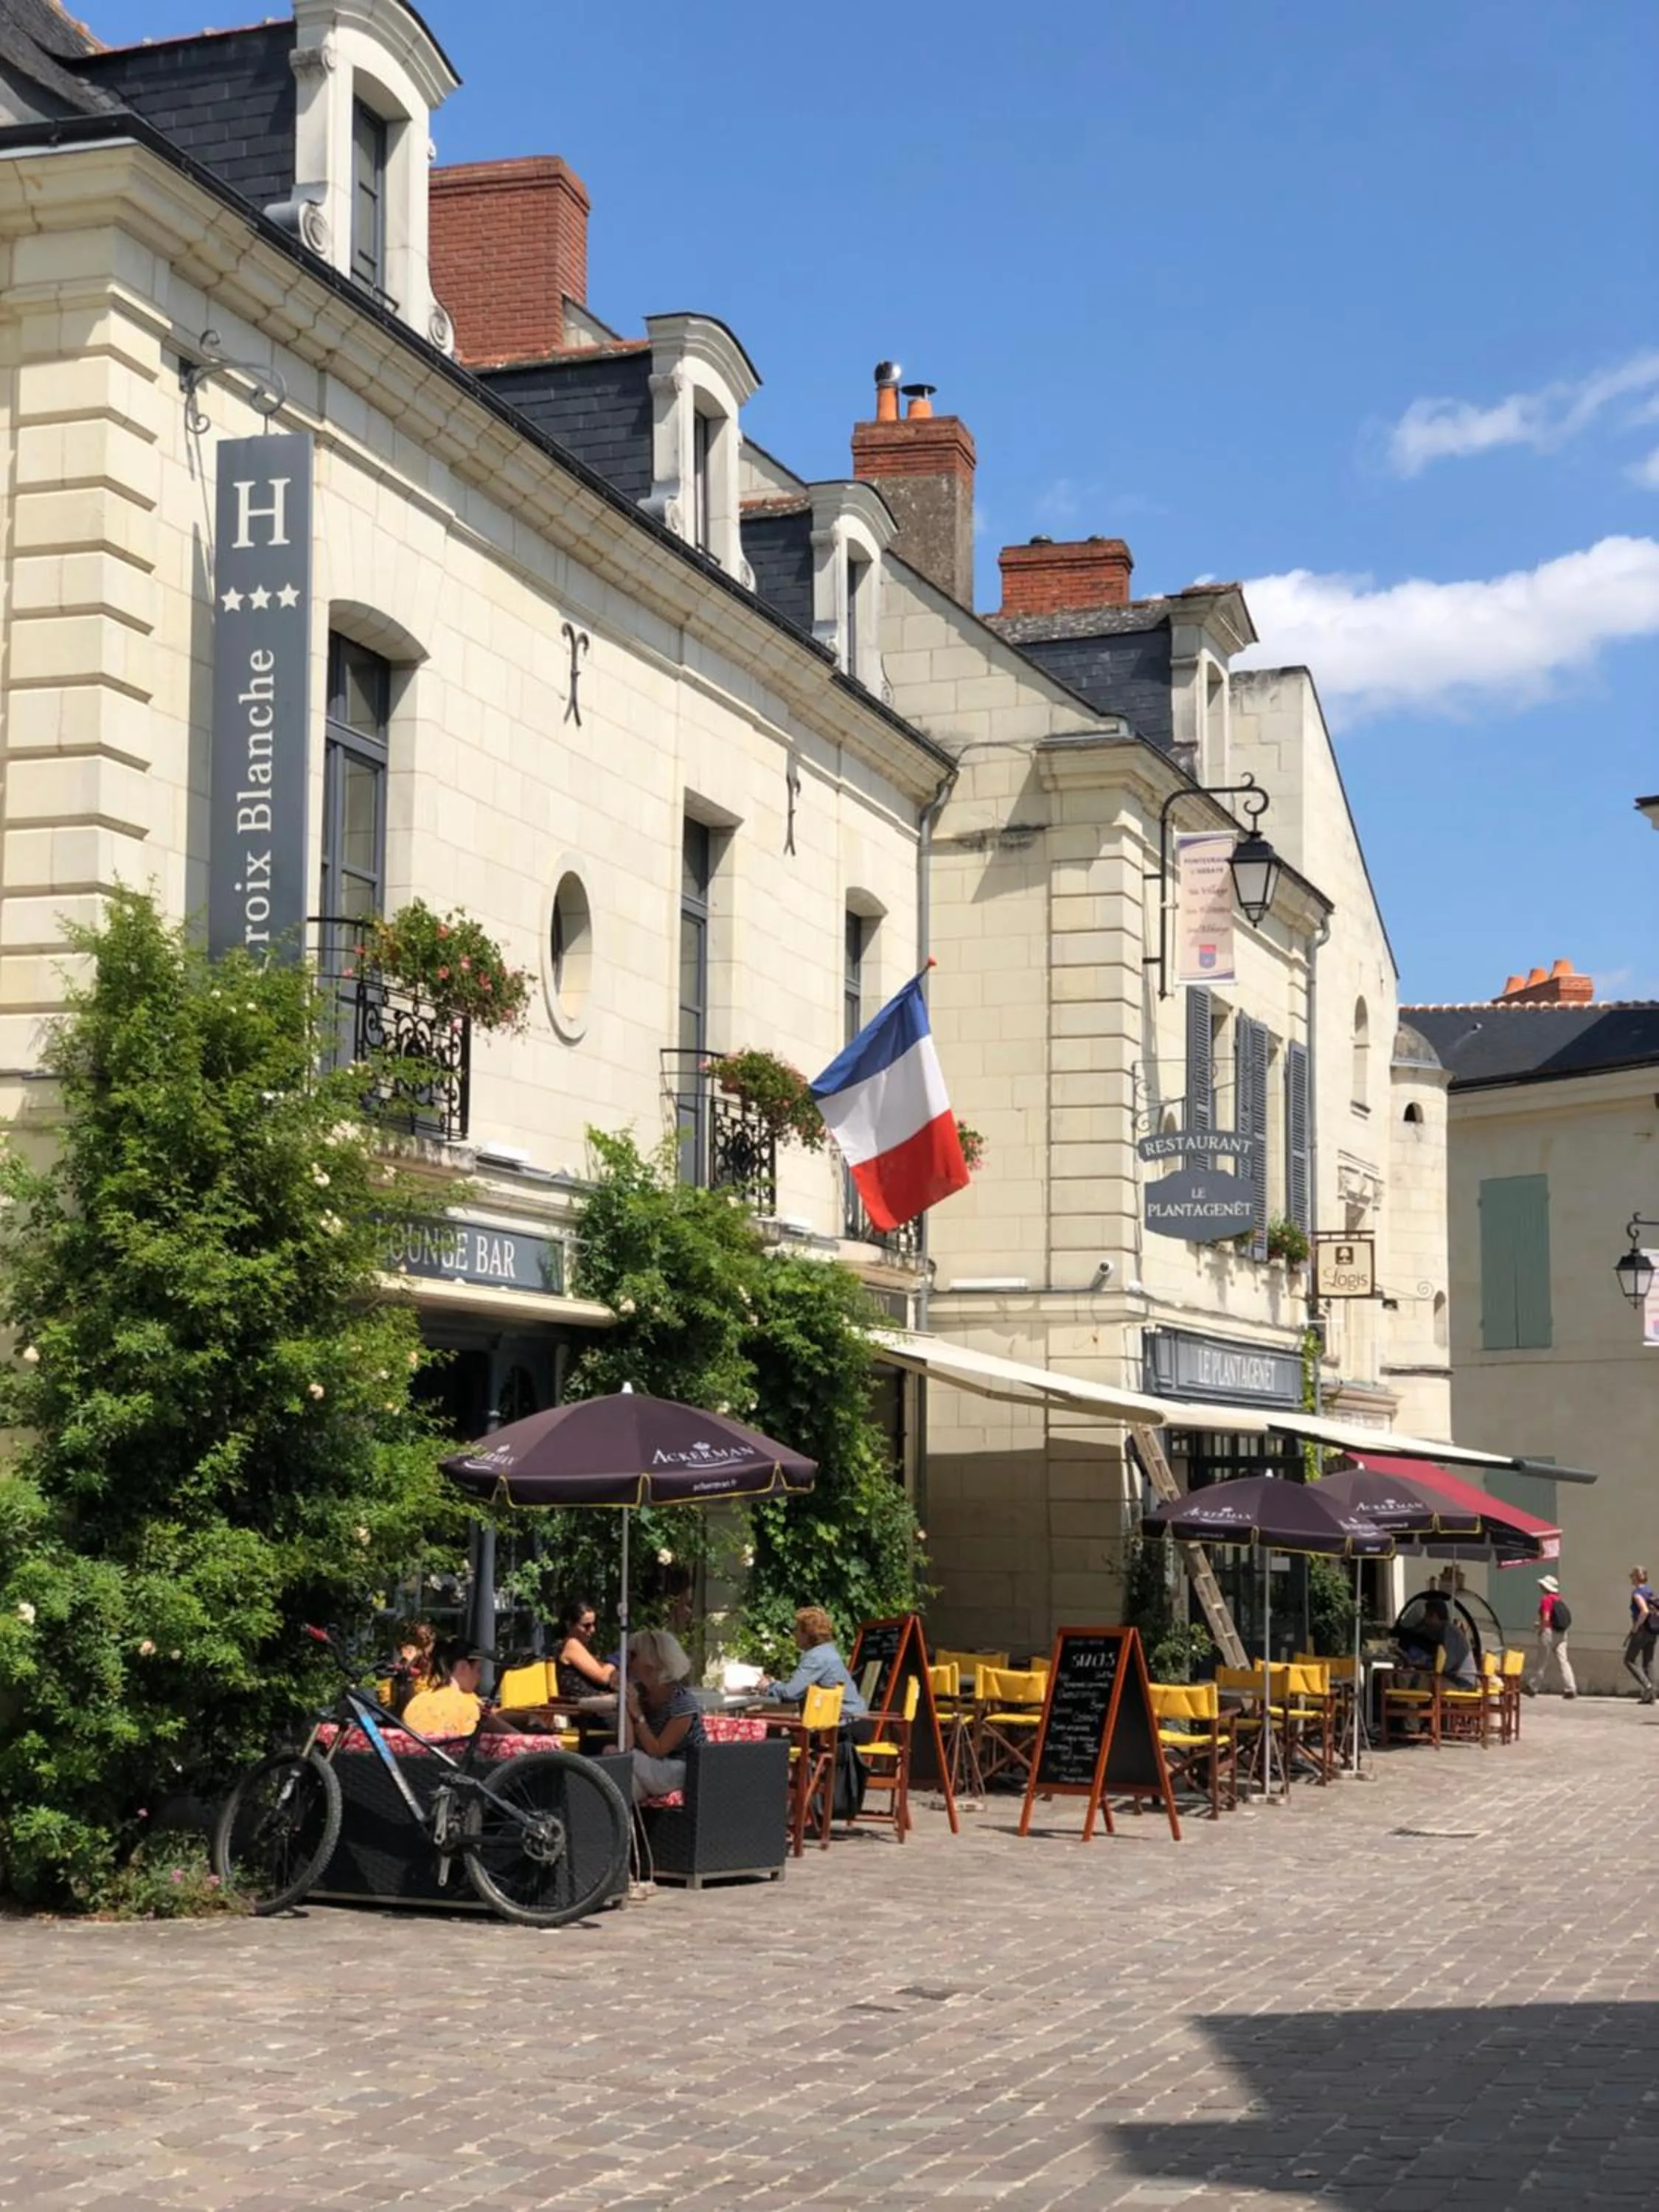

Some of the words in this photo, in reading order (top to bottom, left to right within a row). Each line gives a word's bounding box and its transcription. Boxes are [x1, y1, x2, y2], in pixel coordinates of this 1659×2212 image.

[232, 477, 291, 549] H
[237, 649, 274, 834] Blanche
[1144, 1135, 1253, 1157] RESTAURANT
[1147, 1200, 1252, 1217] PLANTAGENÊT
[1191, 1186, 1206, 1199] LE
[476, 1235, 515, 1279] BAR
